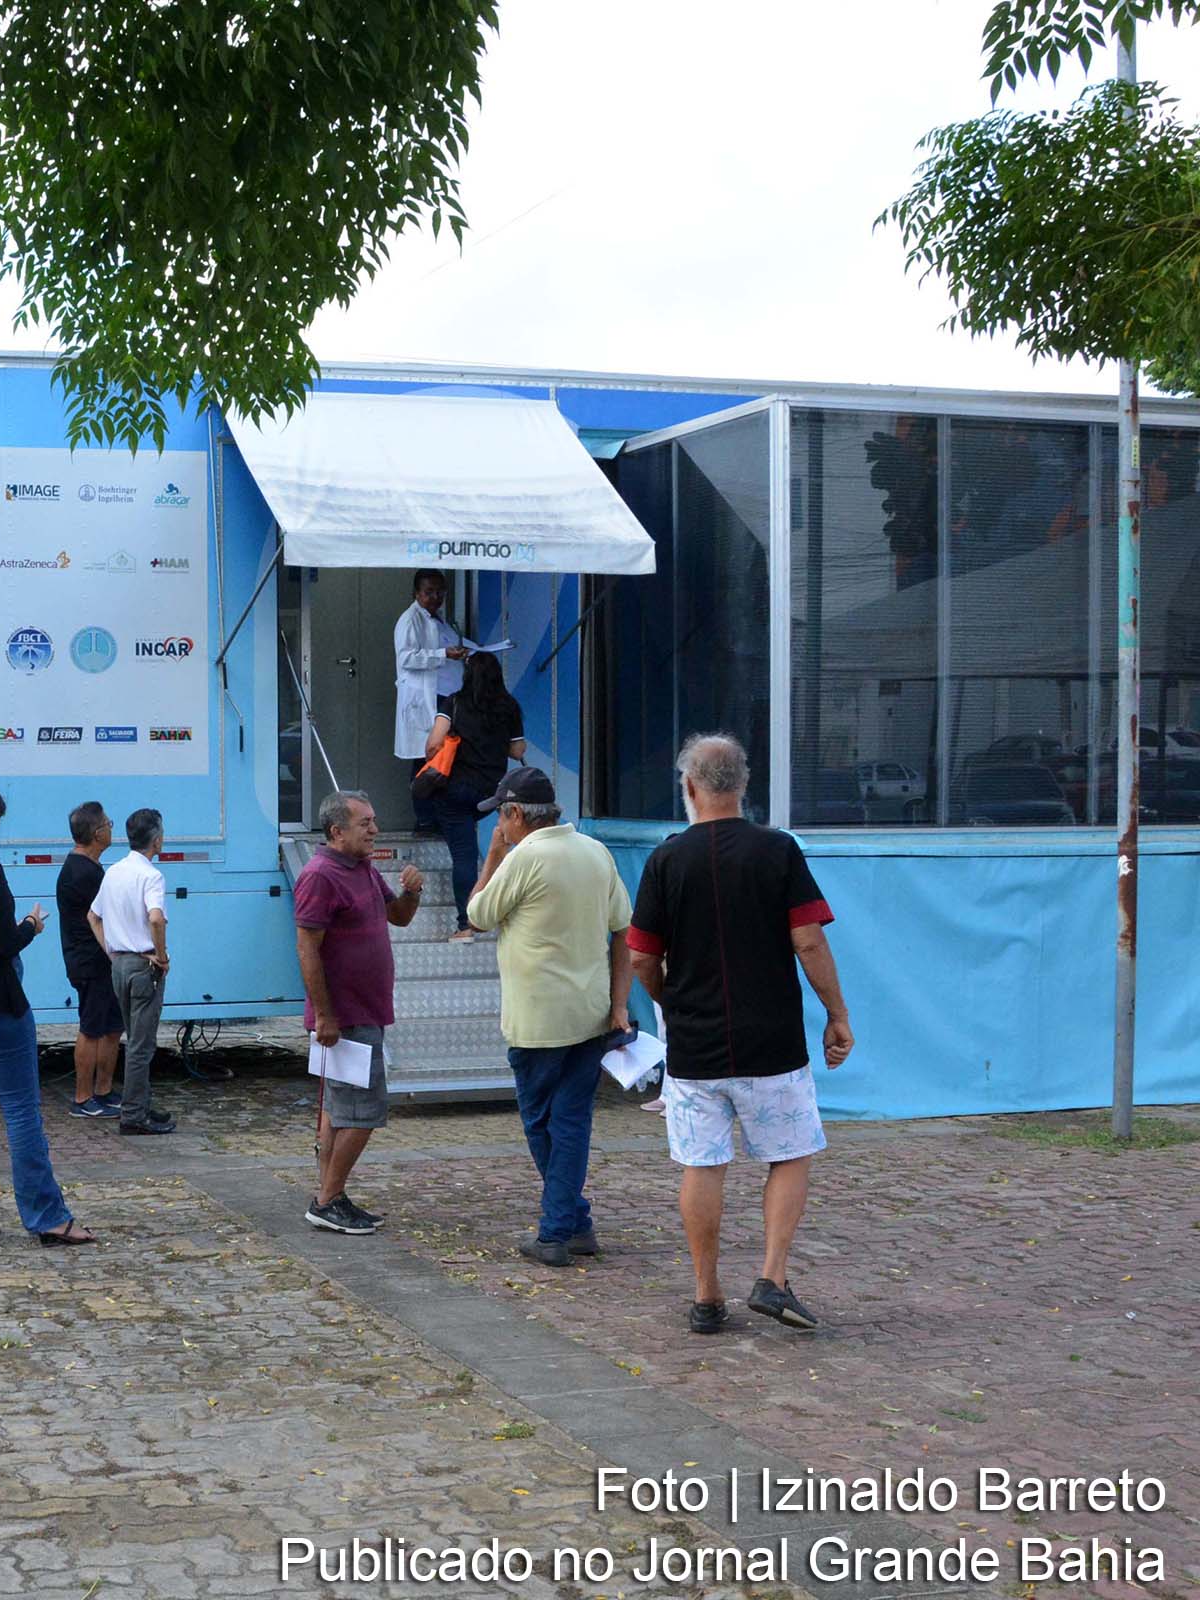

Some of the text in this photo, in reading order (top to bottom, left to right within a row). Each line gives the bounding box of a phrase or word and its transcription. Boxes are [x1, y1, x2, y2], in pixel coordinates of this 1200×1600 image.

[18, 484, 60, 497] IMAGE
[154, 495, 191, 505] abraçar
[407, 538, 512, 560] propulmão
[0, 559, 58, 569] AstraZeneca
[135, 642, 190, 657] INCAR
[54, 729, 81, 739] FEIRA
